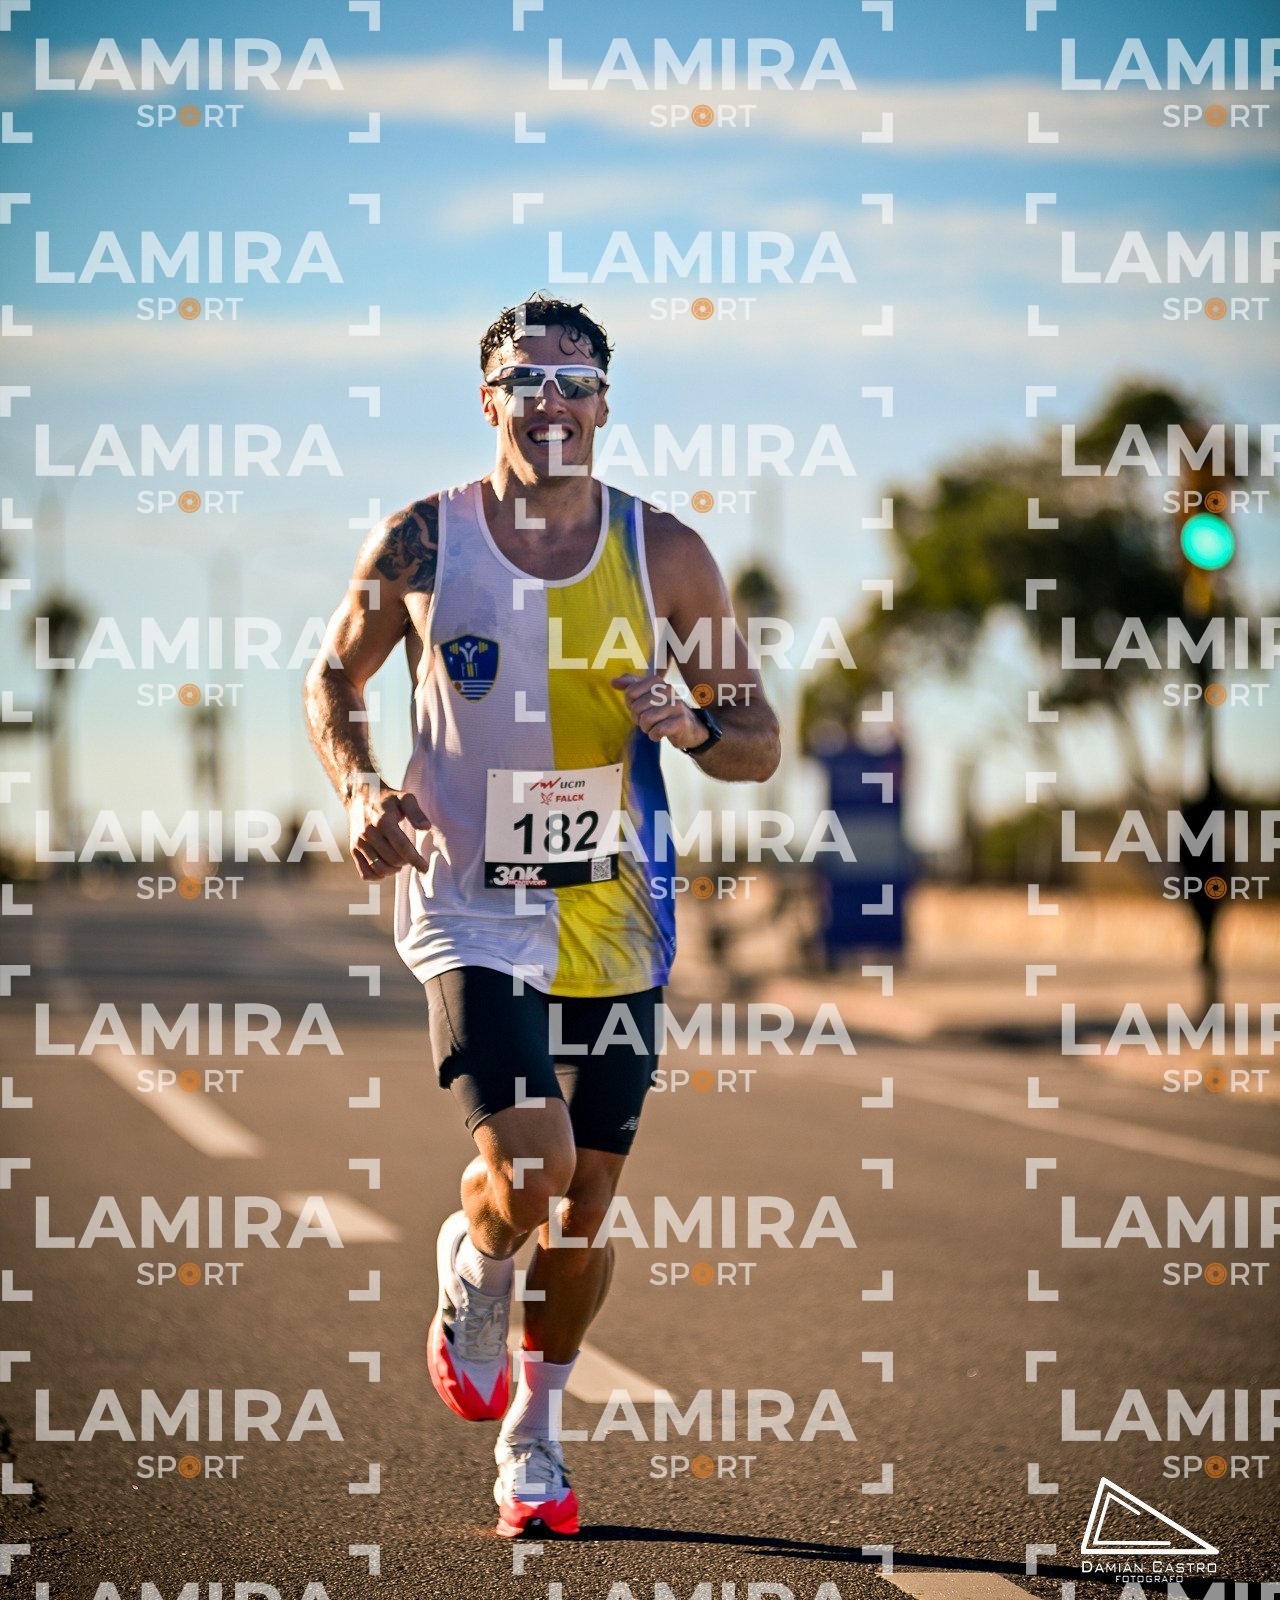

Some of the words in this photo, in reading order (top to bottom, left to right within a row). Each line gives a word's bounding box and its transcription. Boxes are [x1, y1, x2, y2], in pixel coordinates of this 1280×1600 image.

[560, 780, 586, 789] ucm
[556, 793, 585, 803] FALCK
[513, 810, 599, 855] 182
[493, 865, 544, 886] 30K
